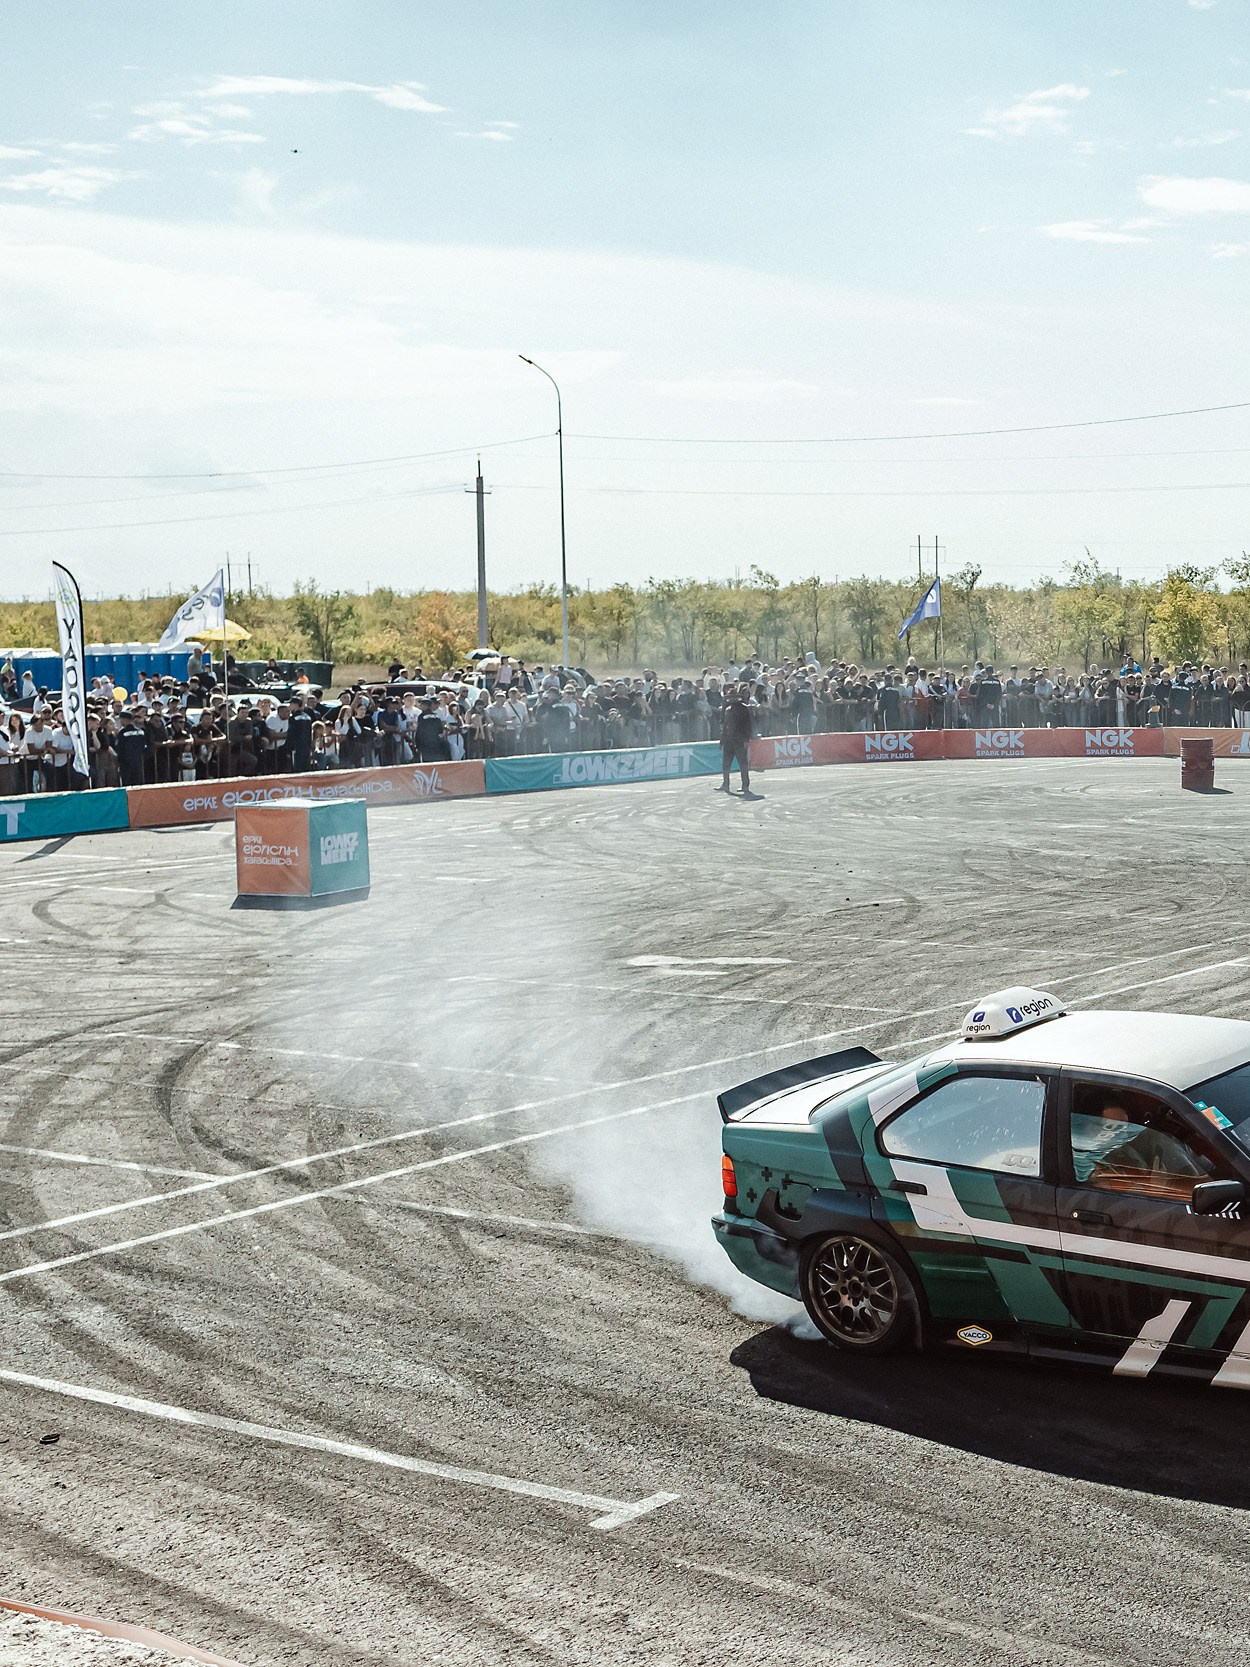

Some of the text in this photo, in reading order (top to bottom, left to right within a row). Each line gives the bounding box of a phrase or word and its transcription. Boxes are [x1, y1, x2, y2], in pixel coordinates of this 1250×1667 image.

[773, 736, 813, 757] NGK
[865, 732, 914, 752] NGK
[975, 730, 1025, 749] NGK
[1085, 729, 1134, 748] NGK
[1020, 998, 1053, 1016] region
[966, 1023, 991, 1034] region
[962, 1331, 988, 1339] YACCO
